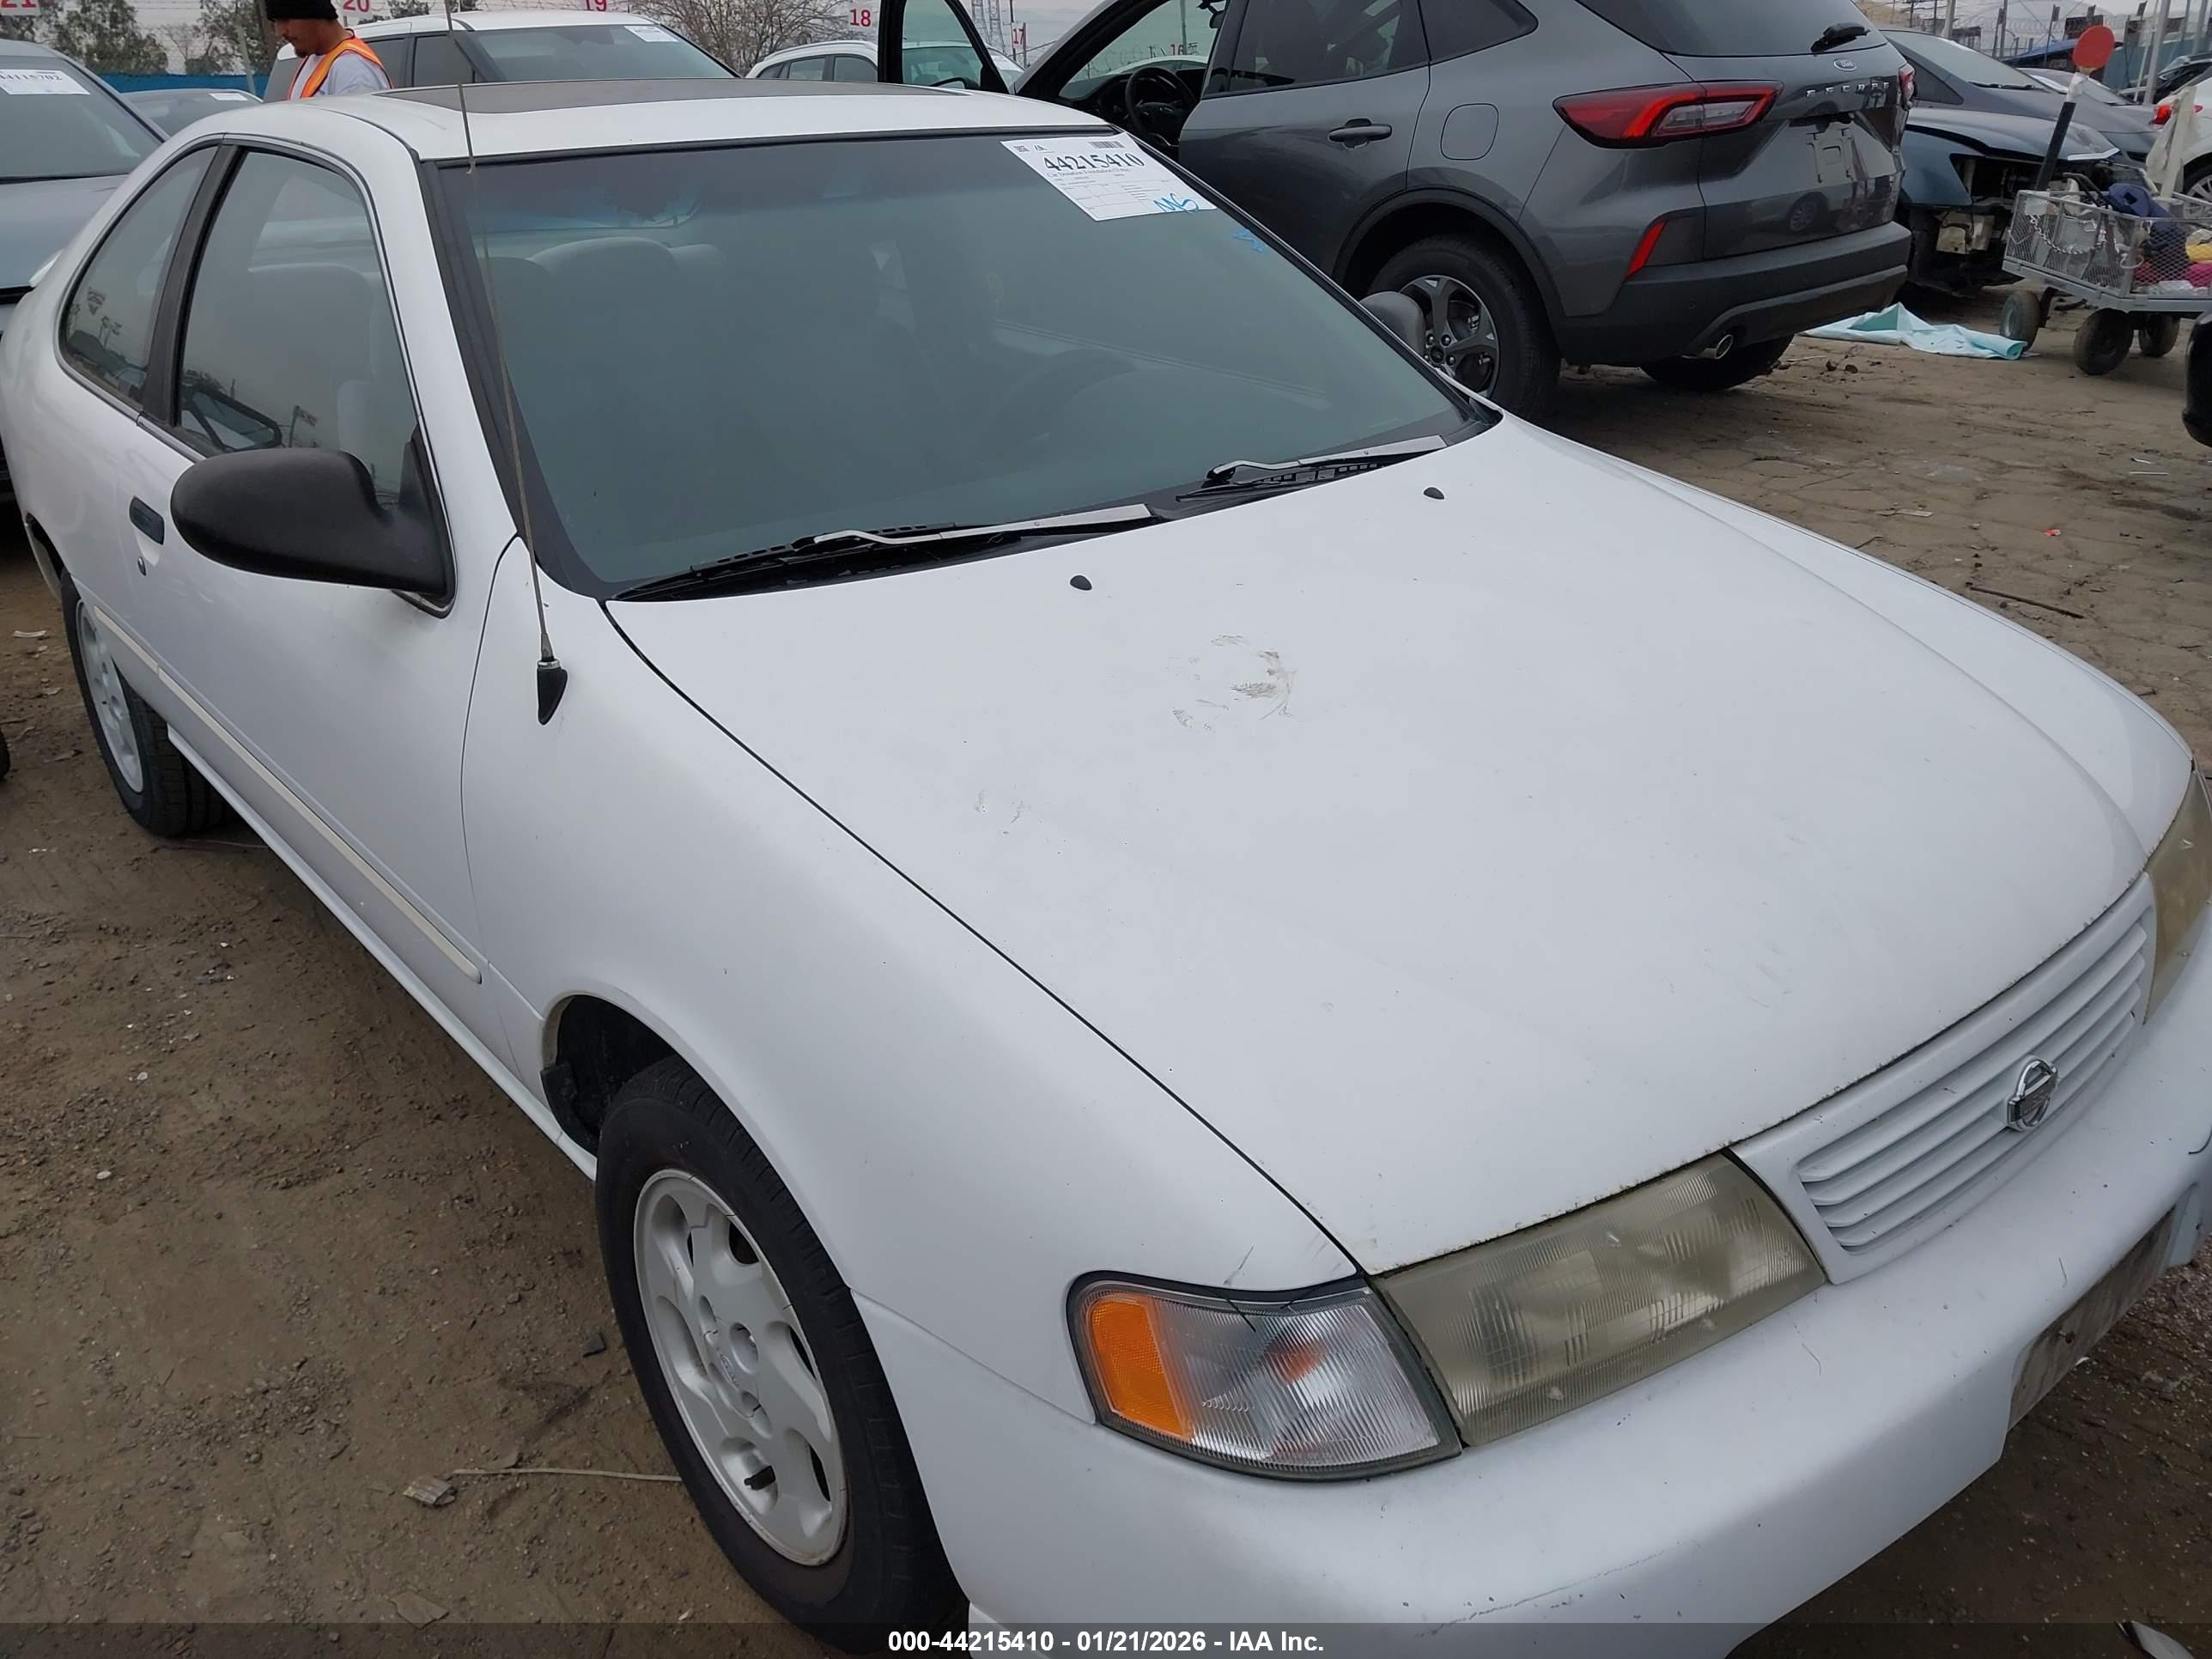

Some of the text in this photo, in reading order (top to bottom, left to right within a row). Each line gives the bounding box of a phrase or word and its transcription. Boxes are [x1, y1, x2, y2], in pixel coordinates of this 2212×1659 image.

[343, 0, 370, 12] 20
[850, 9, 872, 27] 18
[1012, 28, 1024, 45] 17
[1043, 153, 1146, 171] 44215410
